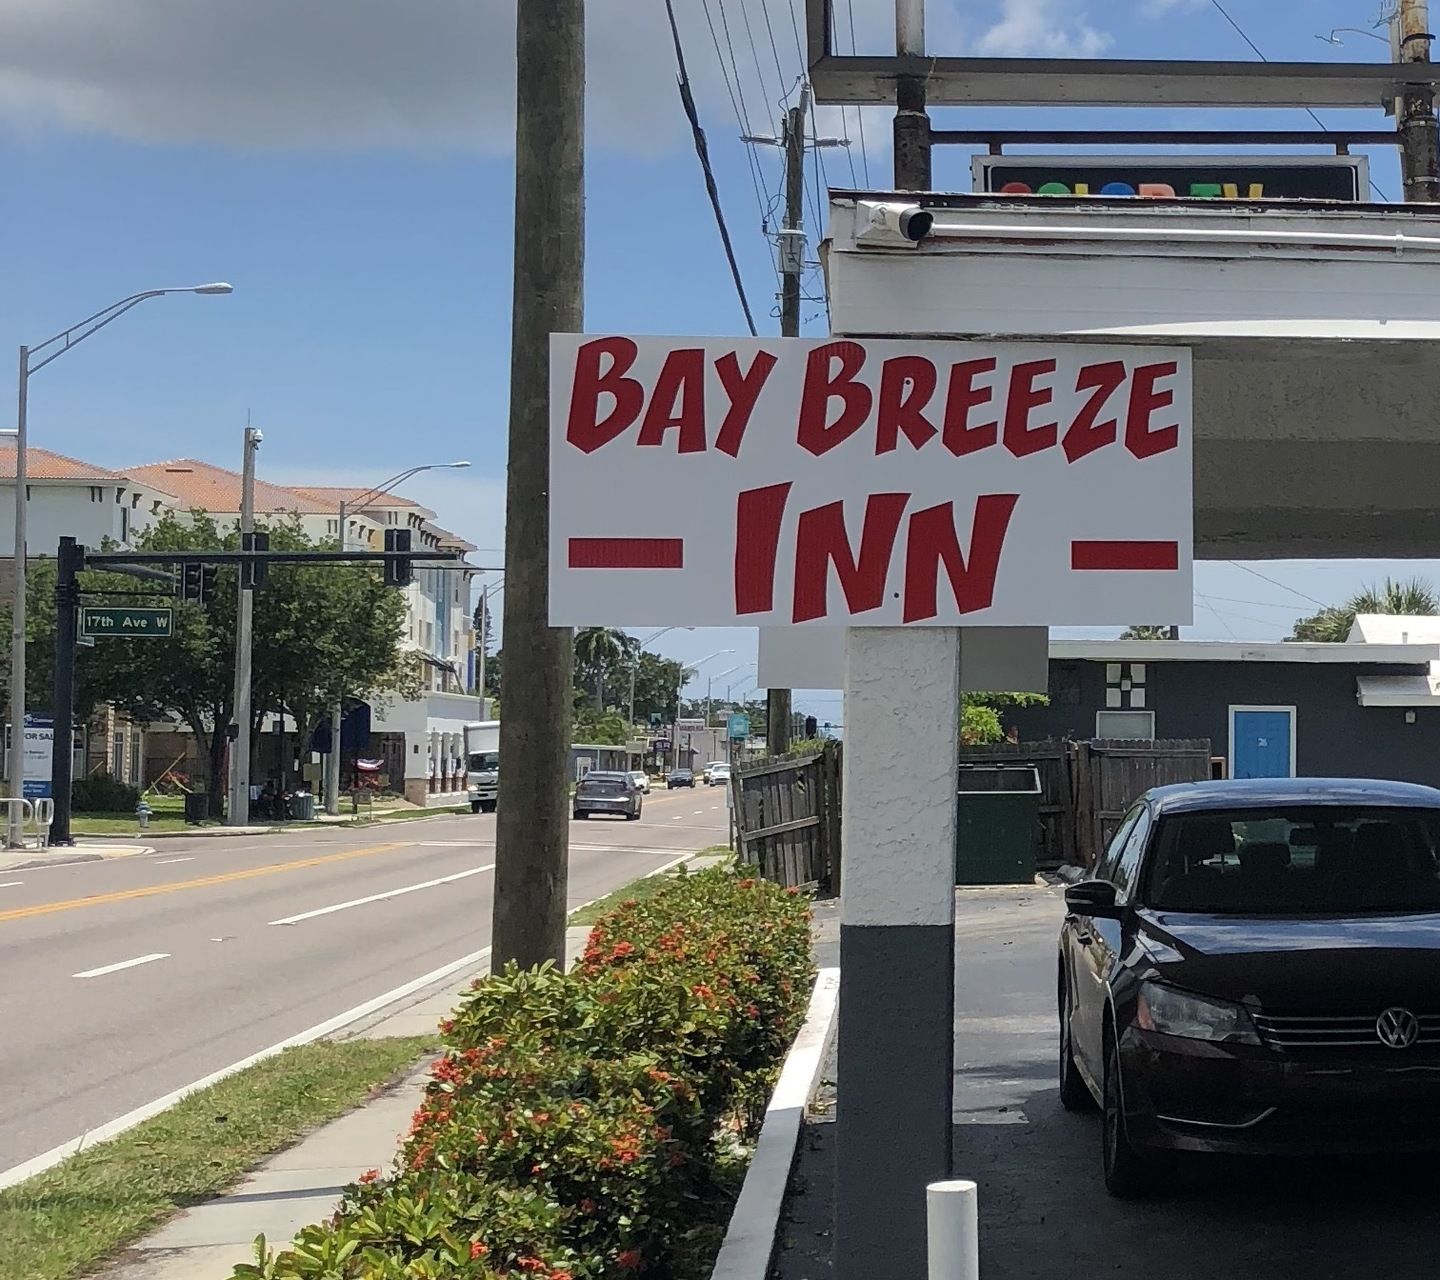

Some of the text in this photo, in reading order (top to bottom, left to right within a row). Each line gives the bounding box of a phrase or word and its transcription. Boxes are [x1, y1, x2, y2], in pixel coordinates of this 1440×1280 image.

[566, 336, 1178, 464] BAY BREEZE
[735, 481, 1020, 624] INN
[87, 616, 168, 627] 17th Ave W
